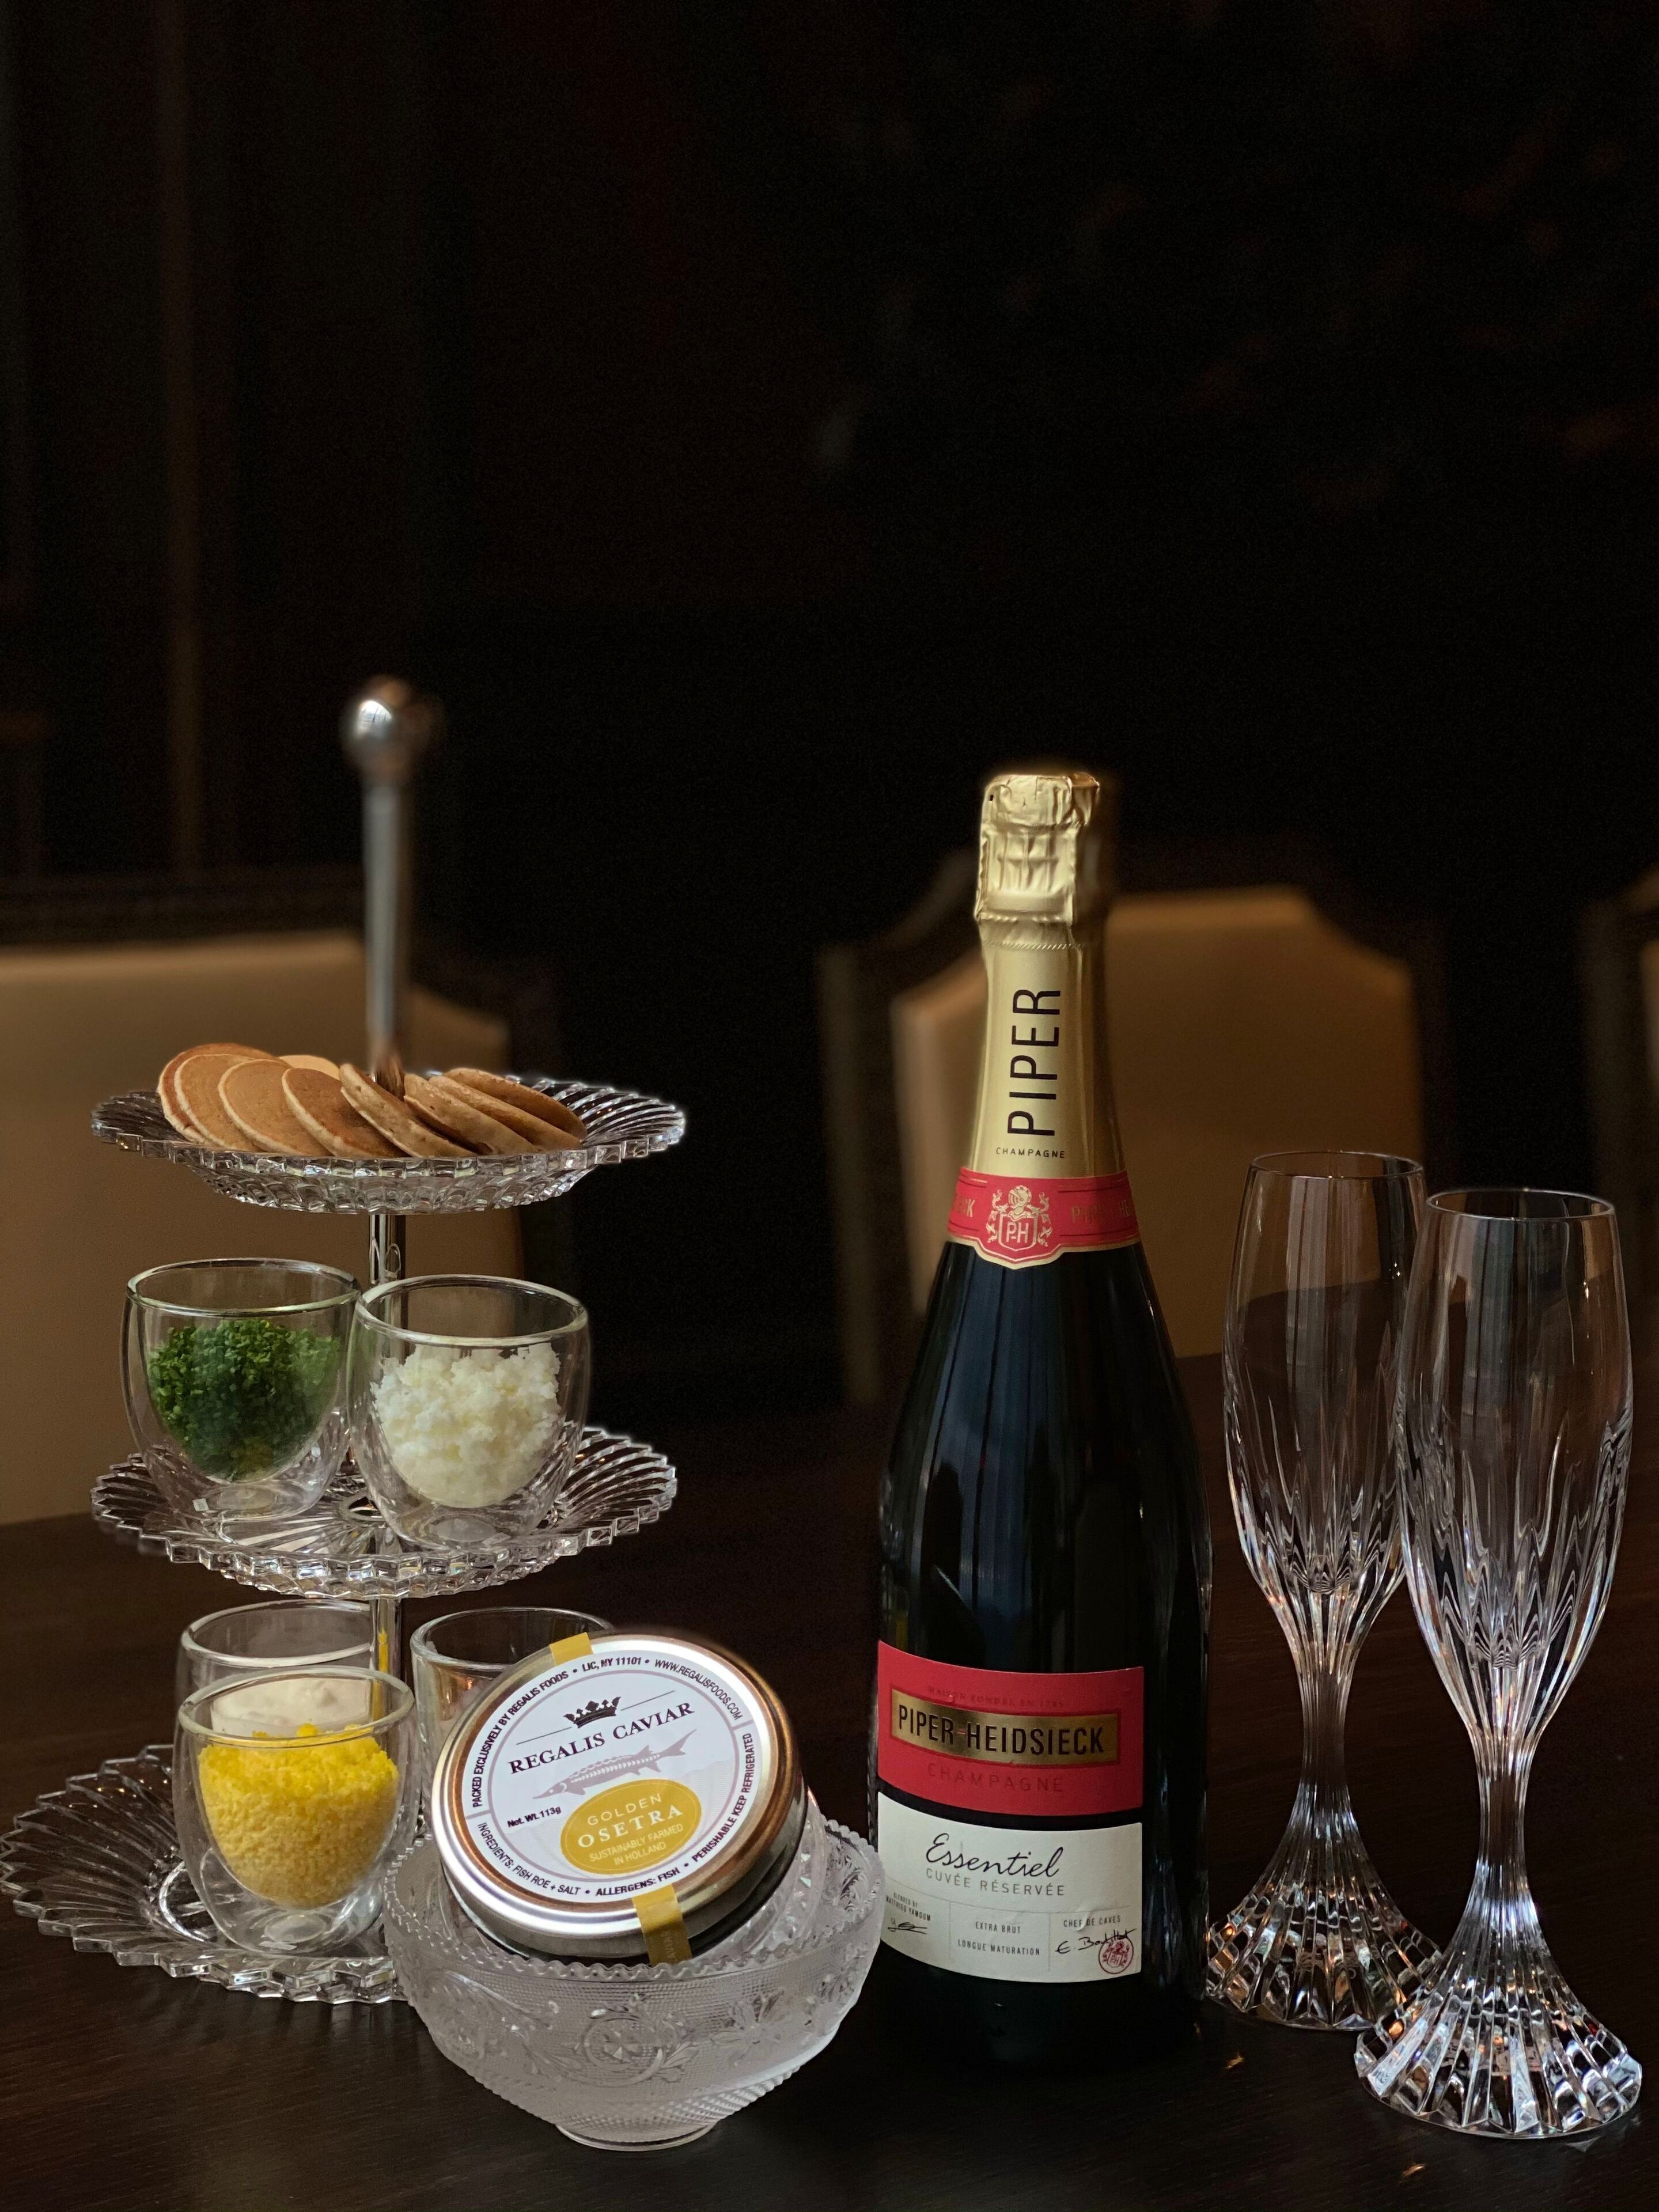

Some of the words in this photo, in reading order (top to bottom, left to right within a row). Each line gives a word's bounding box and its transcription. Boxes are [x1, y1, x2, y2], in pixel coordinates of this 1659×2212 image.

[1007, 989, 1061, 1136] PIPER
[996, 1147, 1065, 1158] CHAMPAGNE
[601, 1658, 613, 1668] NY
[616, 1657, 642, 1666] 11101
[539, 1671, 569, 1691] FOODS
[654, 1659, 743, 1720] WWW.REGALISFOODS.COM
[507, 1687, 540, 1715] REGALIS
[498, 1714, 511, 1726] BY
[474, 1725, 502, 1774] EXCLUSIVELY
[508, 1732, 605, 1774] REGALIS
[613, 1702, 695, 1739] CAVIAR
[927, 1763, 1063, 1792] CHAMPAGNE
[471, 1777, 482, 1808] PACKED
[478, 1823, 514, 1869] INGREDIENTS:
[512, 1865, 532, 1880] FISH
[531, 1876, 550, 1889] ROE
[557, 1884, 581, 1895] SALT
[596, 1878, 656, 1896] ALLERGENS:
[658, 1868, 680, 1882] FISH
[692, 1816, 736, 1862] PERISHABLE
[732, 1795, 747, 1816] KEEP
[741, 1733, 755, 1793] REFRIGERATED
[588, 1793, 661, 1825] GOLDEN
[578, 1805, 683, 1847] OSETRA
[589, 1836, 646, 1862] SUSTAINABLY
[648, 1824, 683, 1840] FARMED
[614, 1856, 624, 1865] IN
[626, 1842, 666, 1862] HOLLAND
[926, 1833, 1063, 1877] Essentiel
[926, 1868, 971, 1888] CUVÉE
[980, 1880, 1065, 1896] RÉSERVÉE
[975, 1922, 998, 1931] EXTRA
[1002, 1925, 1021, 1934] BRUT
[1063, 1919, 1082, 1927] CHEF
[1086, 1918, 1095, 1926] DE
[1099, 1915, 1121, 1924] CAVES
[958, 1939, 987, 1952] LONGUE
[991, 1945, 1040, 1956] MATURATION
